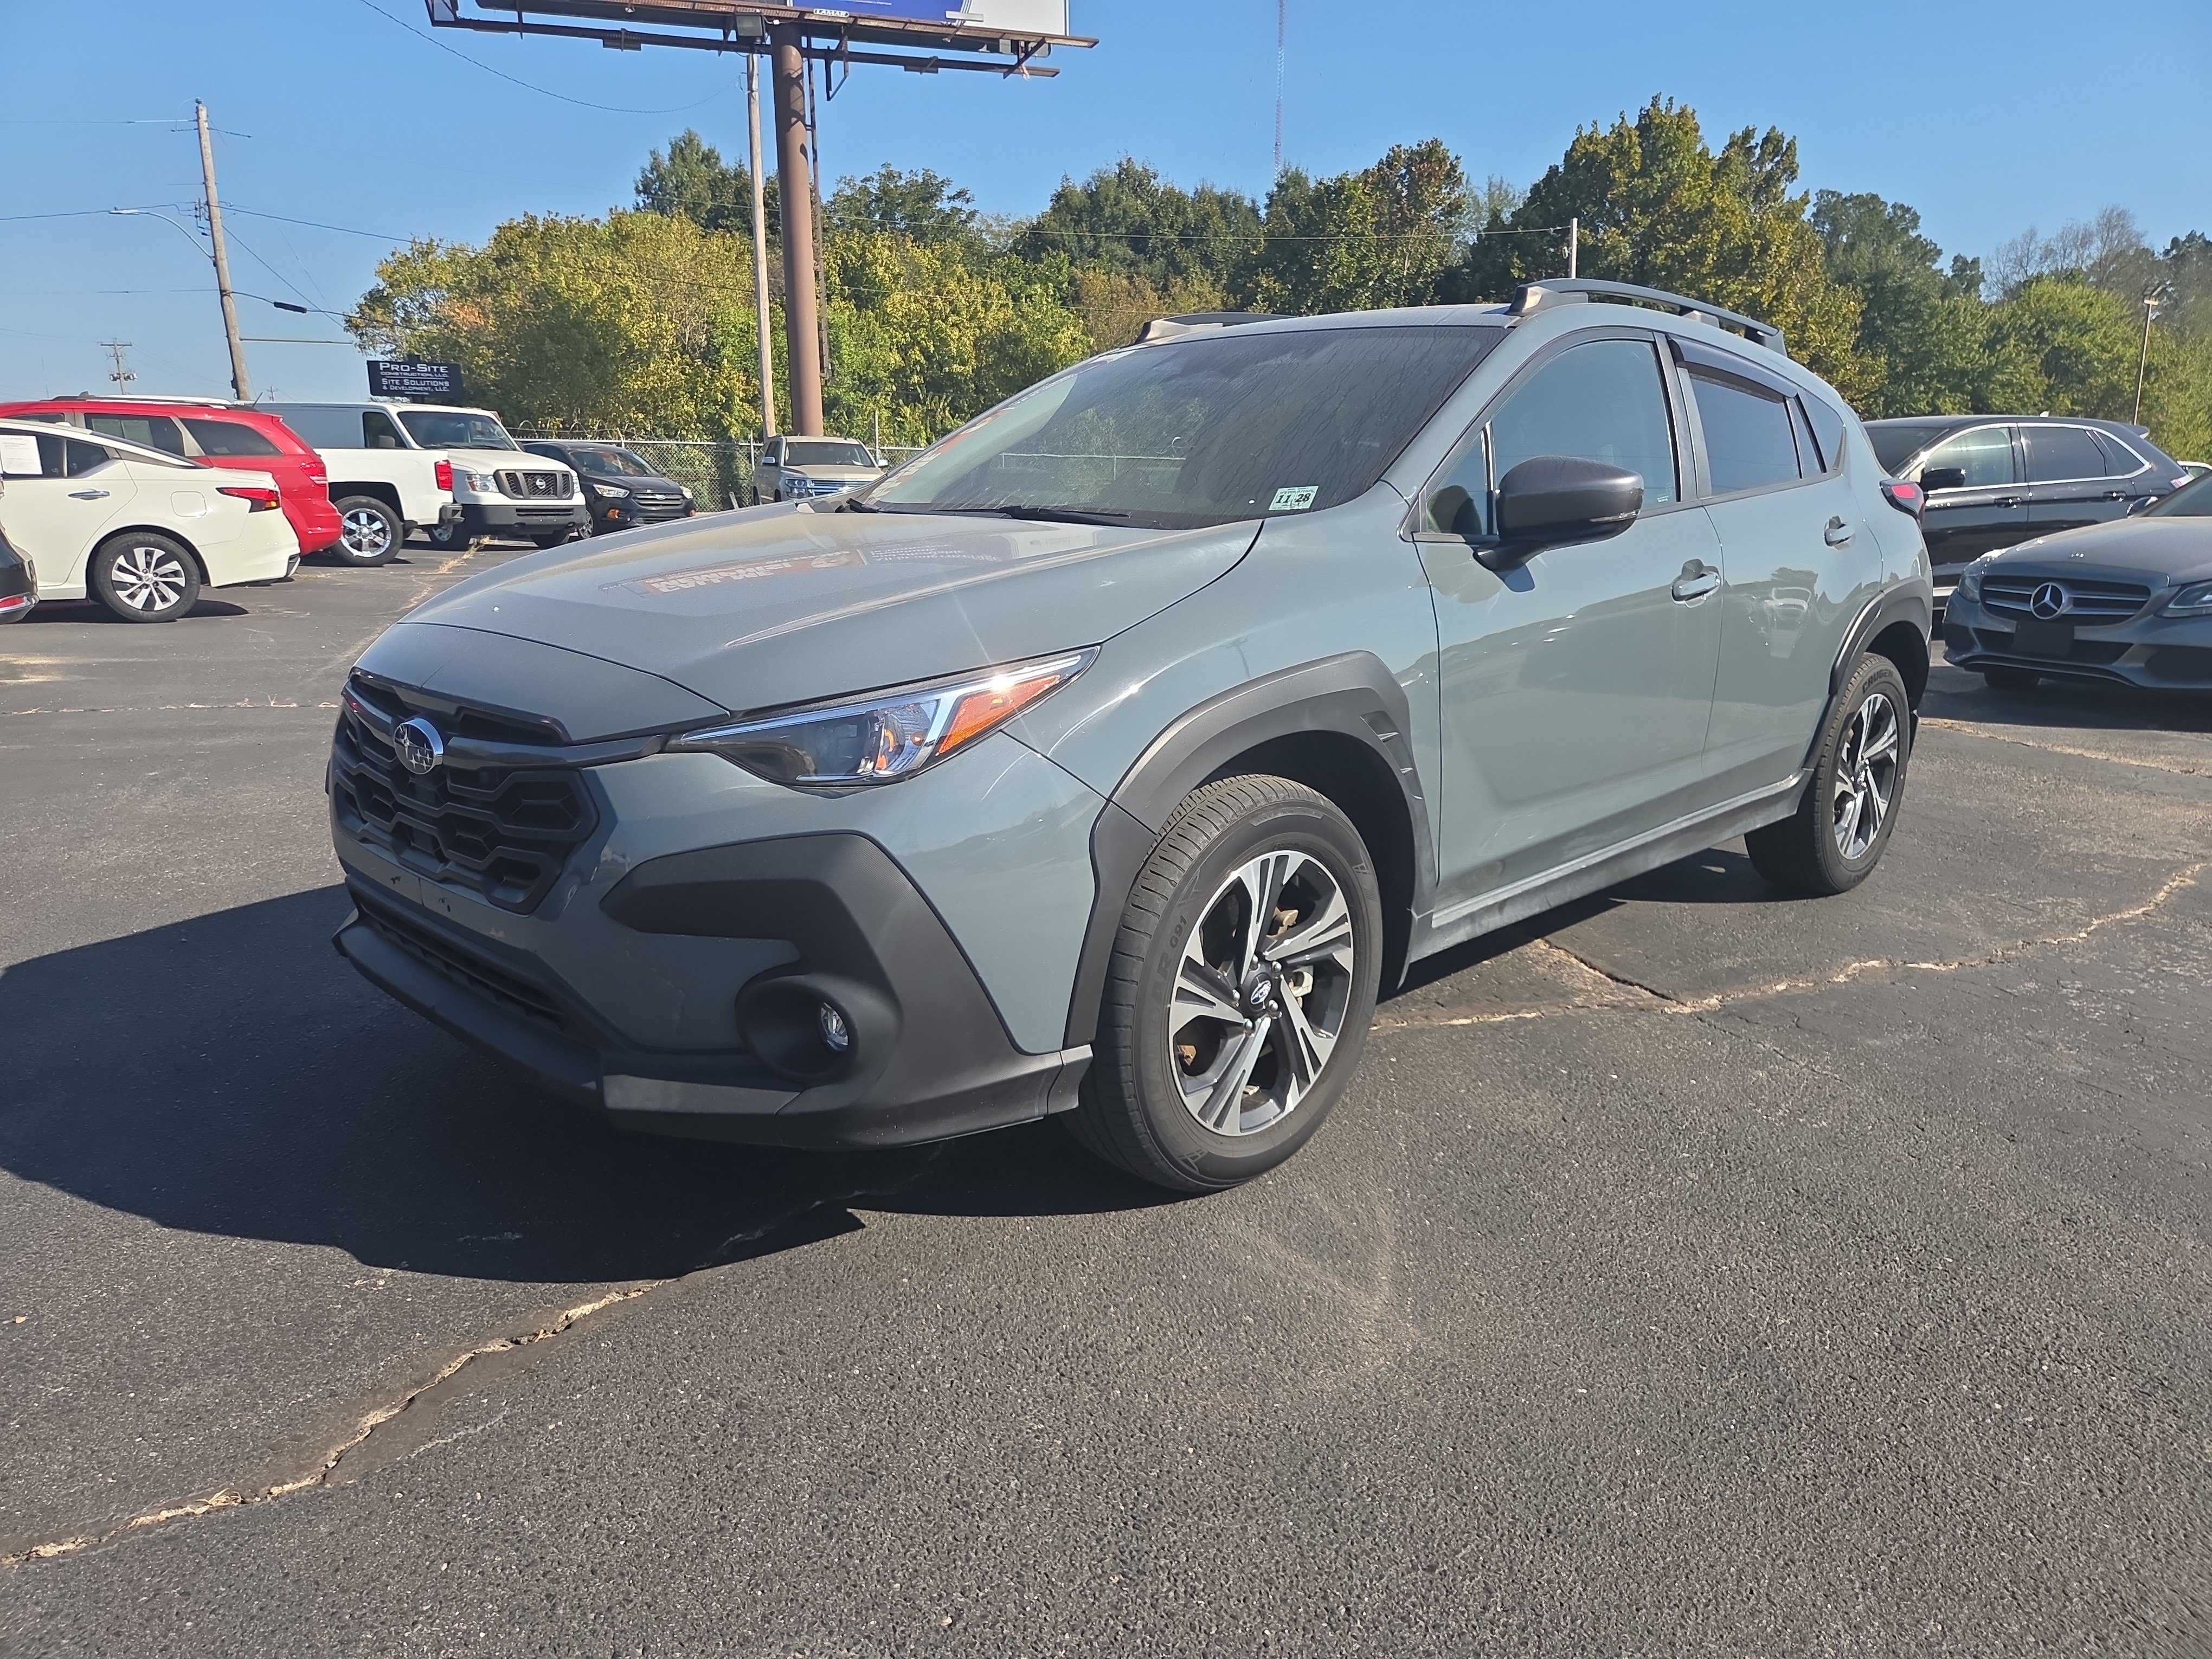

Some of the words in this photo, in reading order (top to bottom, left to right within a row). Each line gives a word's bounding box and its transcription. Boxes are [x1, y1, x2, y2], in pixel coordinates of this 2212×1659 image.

[380, 362, 449, 373] PRO-SITE
[403, 378, 450, 387] SOLUTIONS
[1275, 494, 1292, 504] 11
[1294, 493, 1311, 503] 28
[1169, 914, 1187, 949] G91
